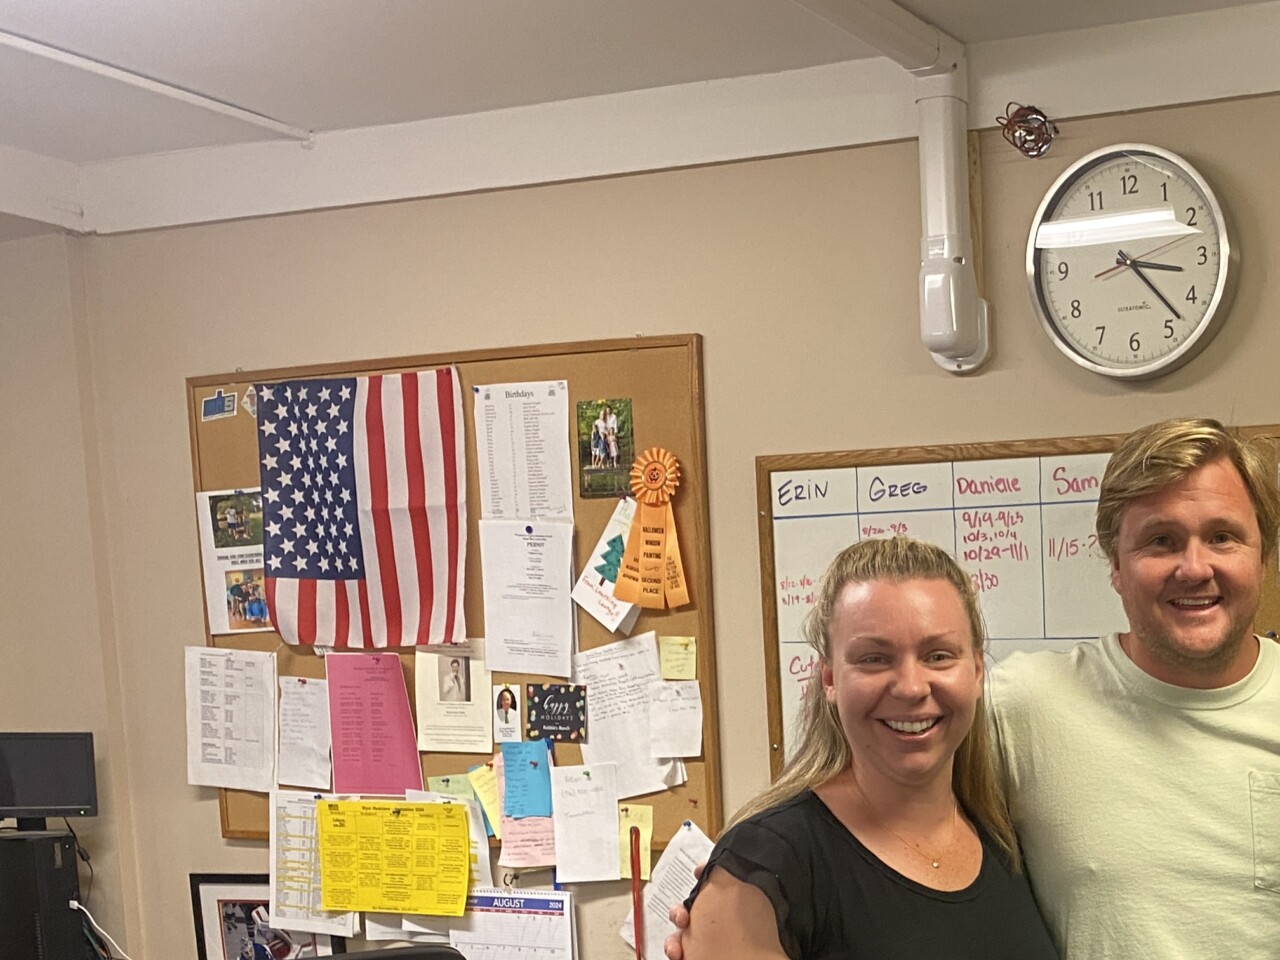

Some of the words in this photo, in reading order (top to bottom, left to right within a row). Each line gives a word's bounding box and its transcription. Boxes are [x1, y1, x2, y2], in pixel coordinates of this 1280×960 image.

[1121, 175, 1139, 195] 12
[1160, 182, 1168, 202] 1
[1087, 191, 1104, 211] 11
[1186, 207, 1197, 226] 2
[1196, 246, 1207, 265] 3
[1058, 262, 1069, 281] 9
[1185, 285, 1197, 304] 4
[1071, 299, 1081, 318] 8
[1095, 326, 1106, 345] 7
[1163, 319, 1174, 339] 5
[1129, 332, 1140, 351] 6
[505, 390, 534, 399] Birthdays
[869, 476, 928, 502] GREG
[957, 476, 1021, 495] Danielle
[1053, 466, 1099, 496] Sam
[543, 694, 568, 714] happy
[492, 898, 525, 908] AUGUST
[549, 901, 562, 909] 2024
